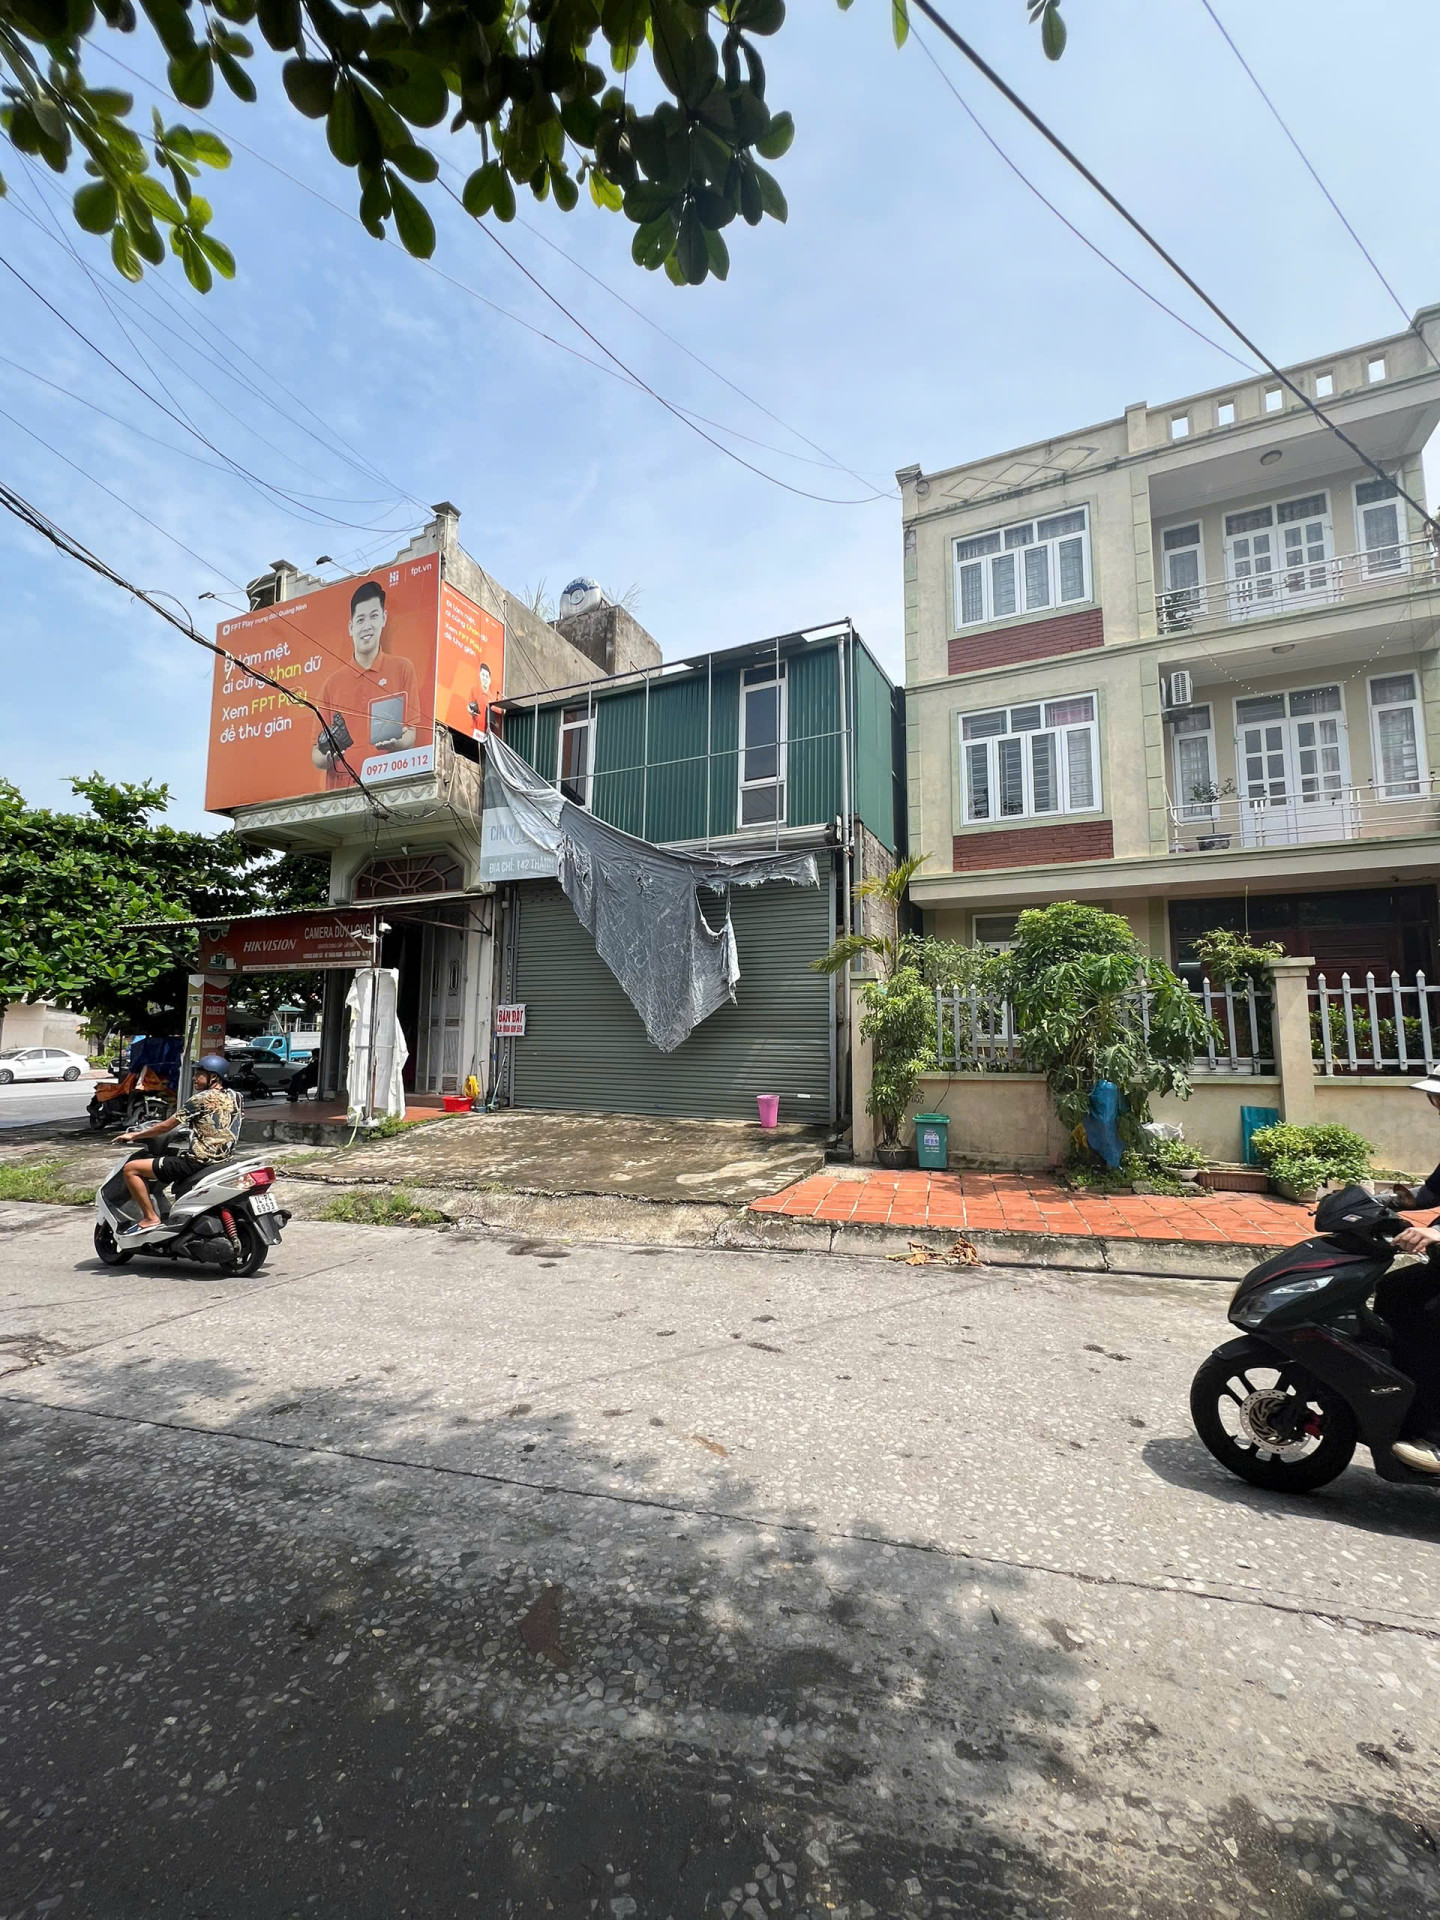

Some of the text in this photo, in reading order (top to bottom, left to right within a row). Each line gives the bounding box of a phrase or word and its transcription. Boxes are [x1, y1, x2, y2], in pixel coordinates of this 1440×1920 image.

[411, 563, 432, 576] fpt.vn
[230, 622, 241, 632] FPT
[242, 619, 254, 629] Play
[295, 603, 308, 613] Ninh
[264, 641, 291, 661] mệt
[222, 678, 234, 694] ai
[269, 663, 302, 681] than
[304, 654, 322, 673] dữ
[221, 705, 249, 721] Xem
[251, 695, 276, 714] FPT
[220, 716, 292, 743] để thư giãn
[366, 754, 428, 776] 0977 006 112
[517, 859, 530, 871] 142
[304, 926, 334, 940] CAMERA
[334, 924, 350, 938] DUY
[243, 938, 297, 952] HIKVISION
[205, 1005, 226, 1015] CAMERA
[498, 1006, 524, 1023] BÁN ĐẤT
[256, 1201, 275, 1213] 6953
